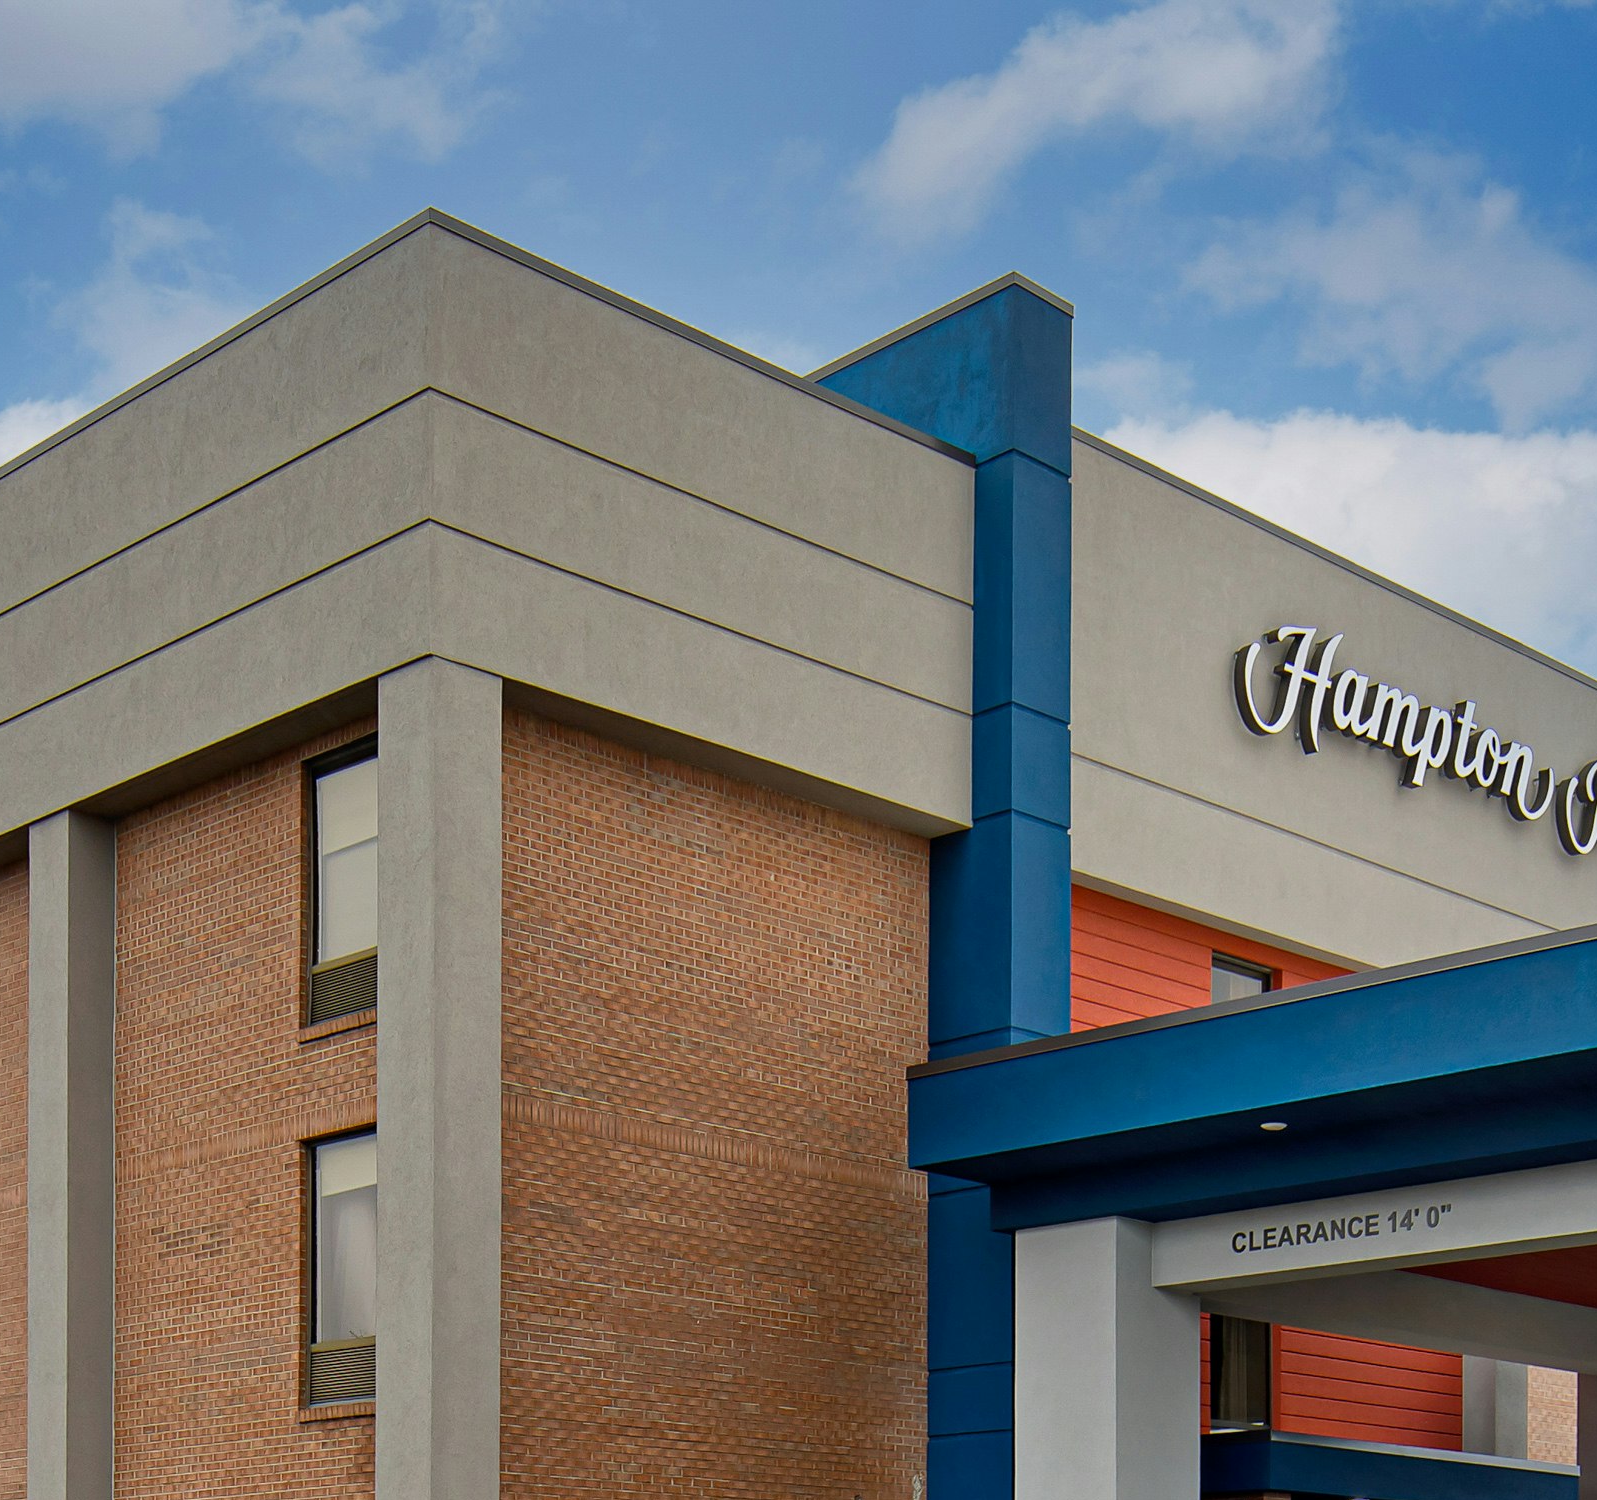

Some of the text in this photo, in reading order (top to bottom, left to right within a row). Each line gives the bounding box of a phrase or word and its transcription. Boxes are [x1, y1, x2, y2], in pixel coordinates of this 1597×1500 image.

[1234, 625, 1554, 822] Hampton
[1231, 1213, 1380, 1254] CLEARANCE
[1387, 1209, 1420, 1233] 14'
